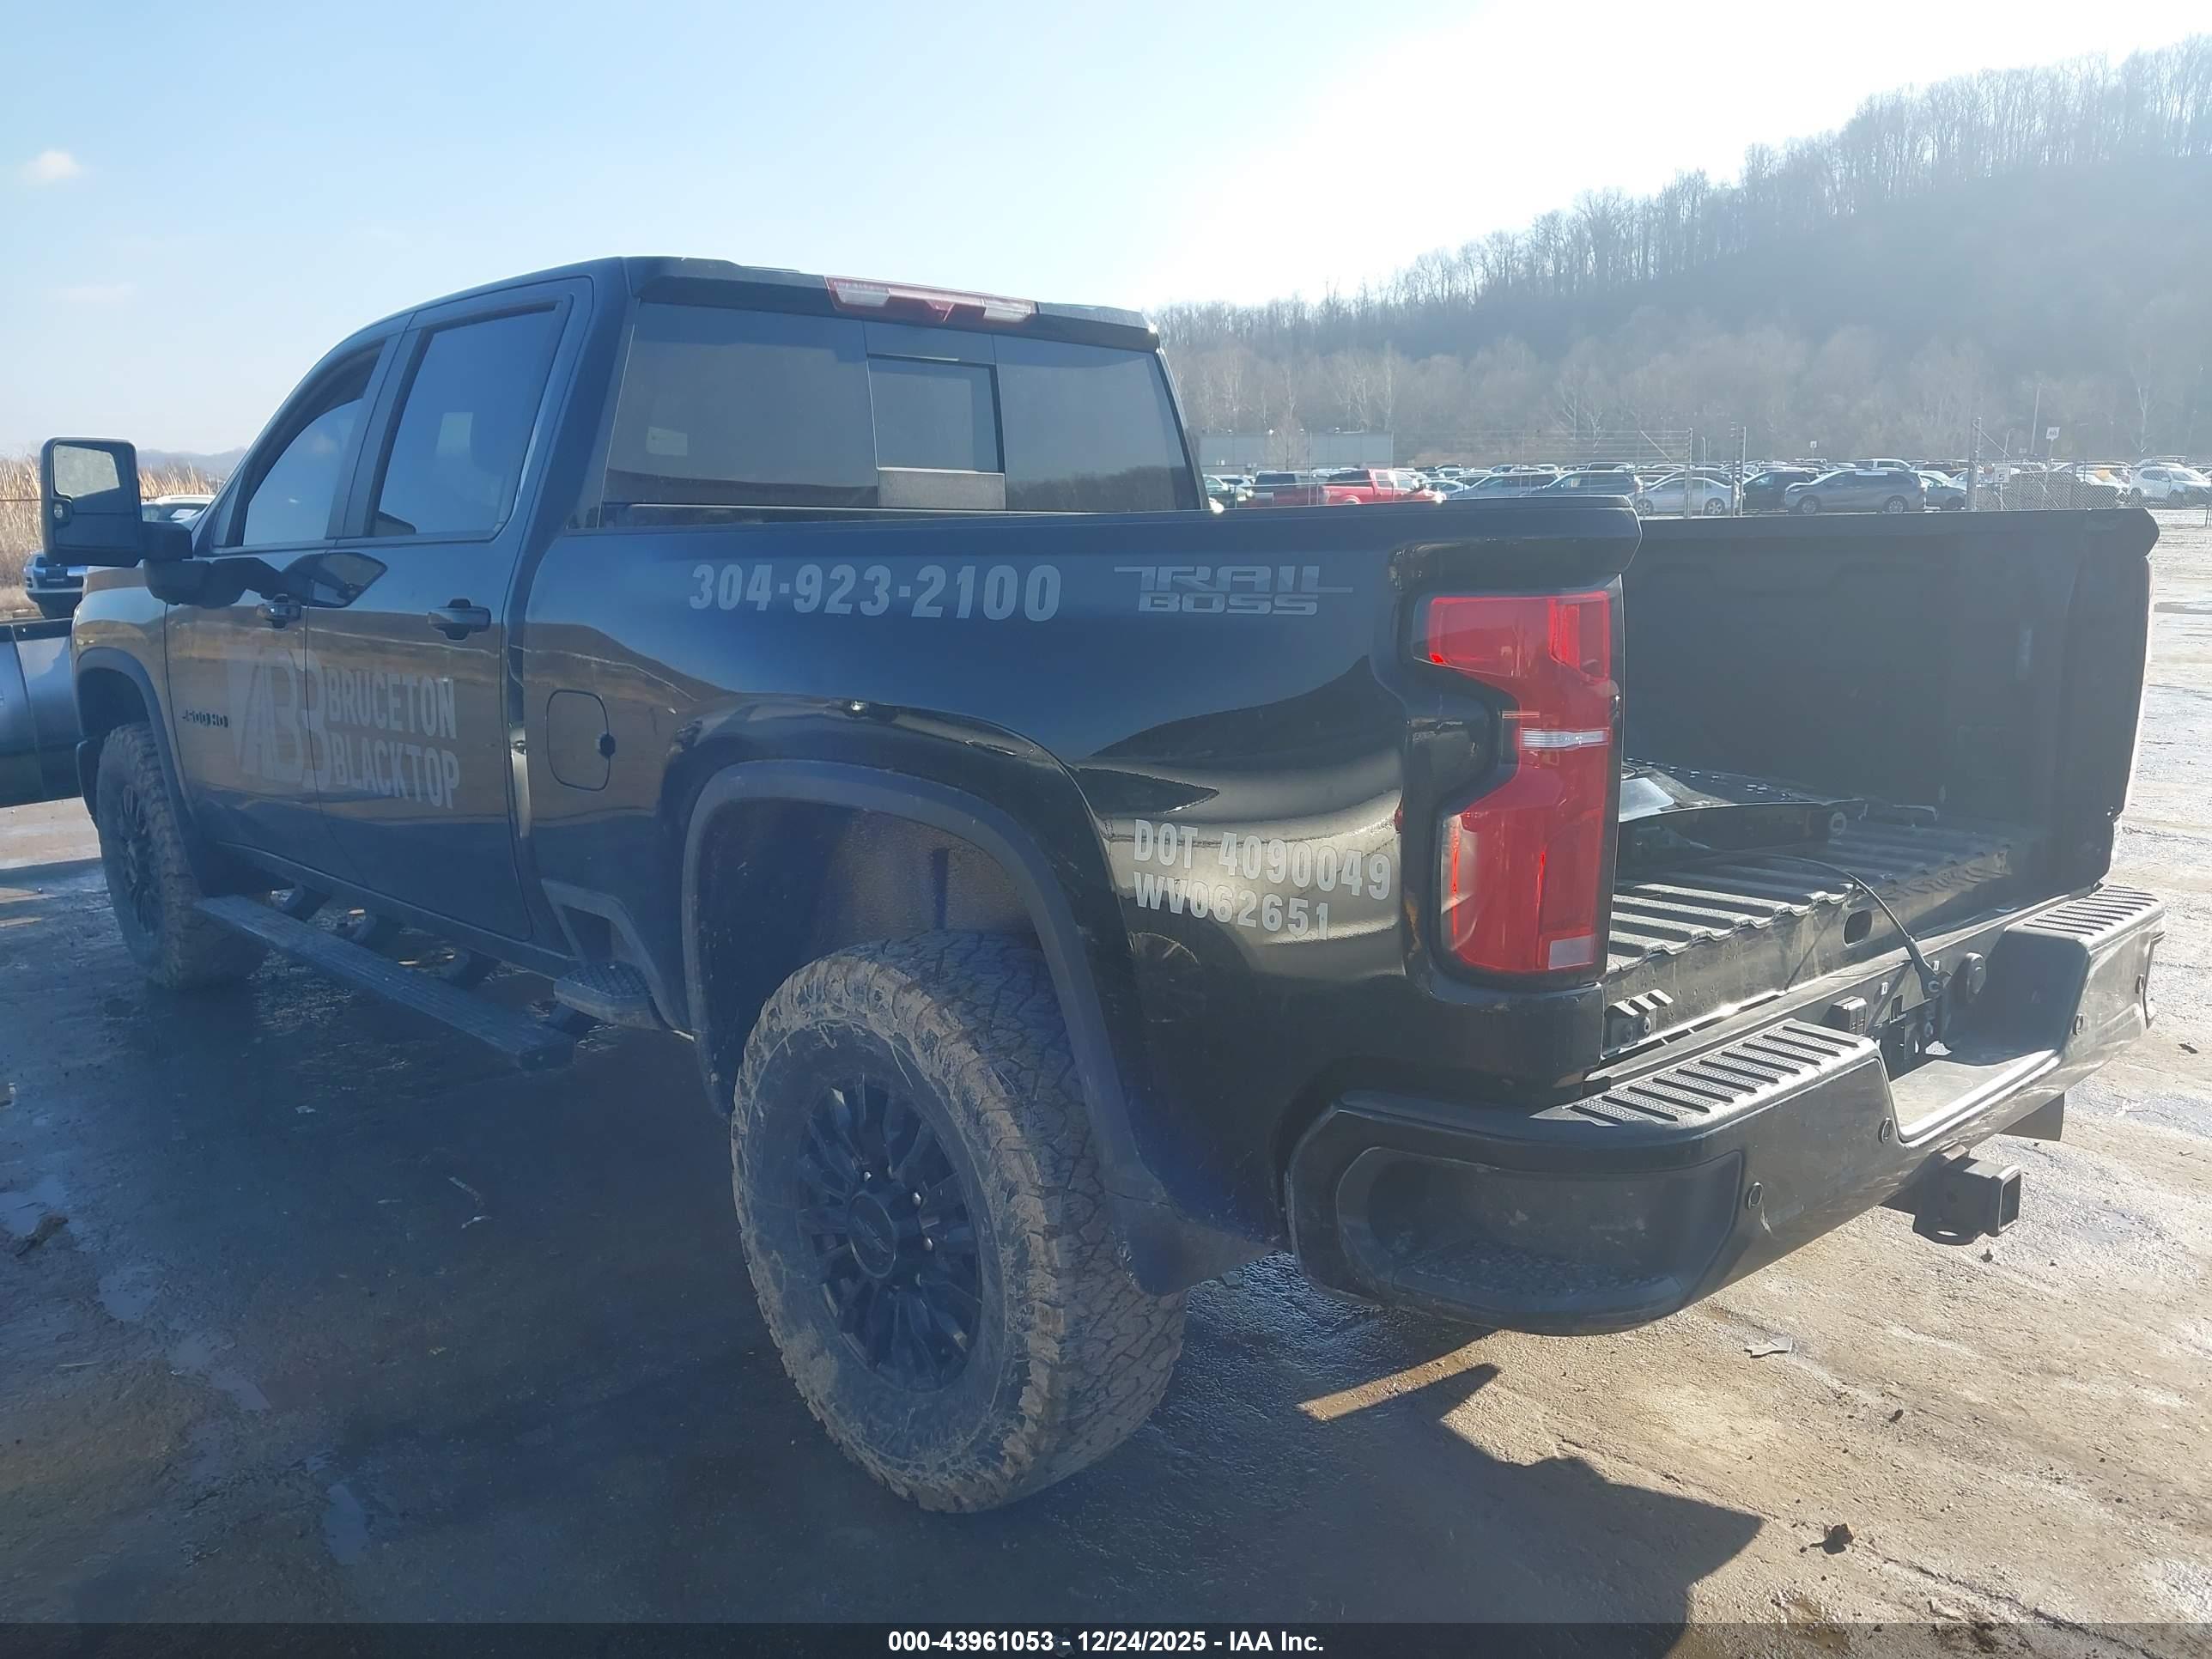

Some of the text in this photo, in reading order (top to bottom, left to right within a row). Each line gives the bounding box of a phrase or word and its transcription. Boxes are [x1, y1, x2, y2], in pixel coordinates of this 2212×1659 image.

[1114, 565, 1354, 593] TRAIL
[1138, 592, 1318, 616] BOSS
[326, 665, 457, 739] BRUCETON
[331, 732, 460, 810] BLACKTOP
[1133, 818, 1391, 900] DOT 4090049
[1133, 872, 1329, 941] WV062651
